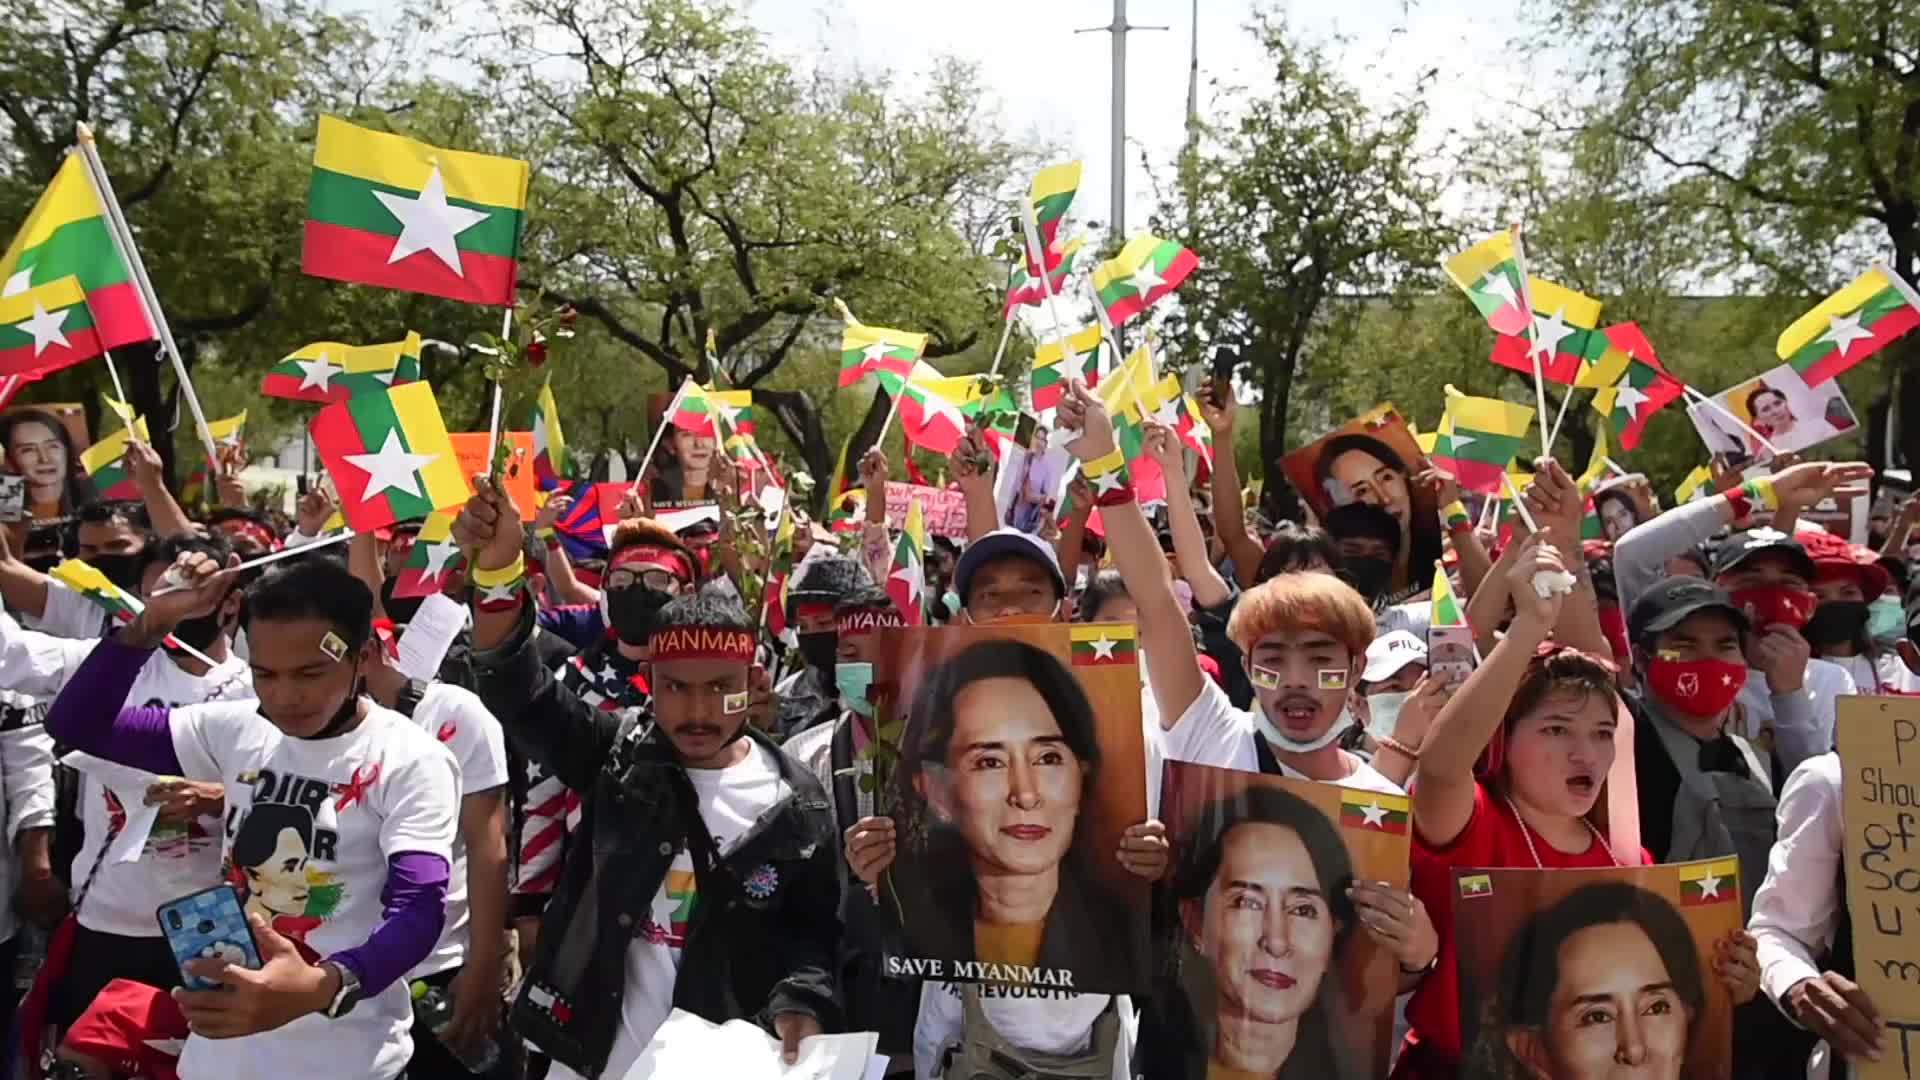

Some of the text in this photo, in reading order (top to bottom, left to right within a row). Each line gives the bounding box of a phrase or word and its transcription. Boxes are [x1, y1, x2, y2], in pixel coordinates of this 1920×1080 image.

[1863, 813, 1915, 851] of
[888, 956, 1073, 987] SAVE MYANMAR
